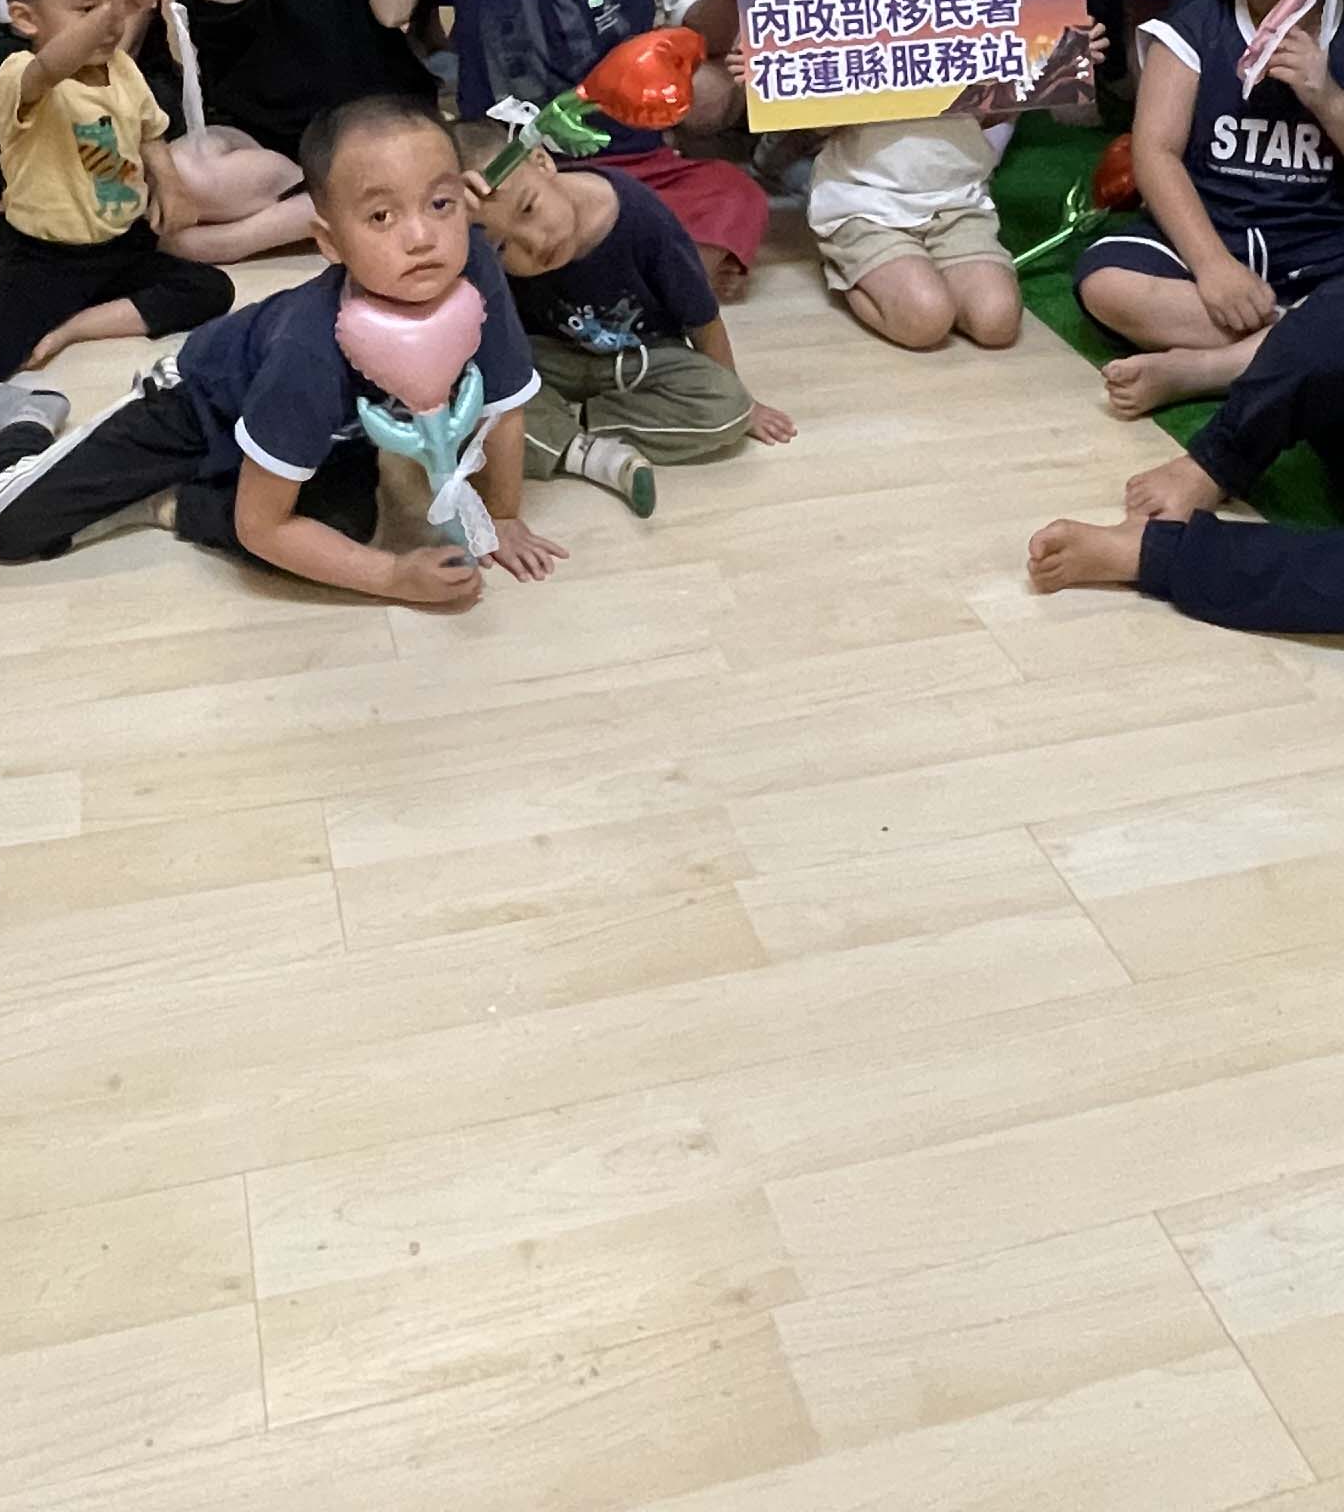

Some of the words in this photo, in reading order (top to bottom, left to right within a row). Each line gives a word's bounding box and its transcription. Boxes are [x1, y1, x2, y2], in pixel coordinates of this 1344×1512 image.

[752, 33, 1025, 100] 花蓮縣服務站
